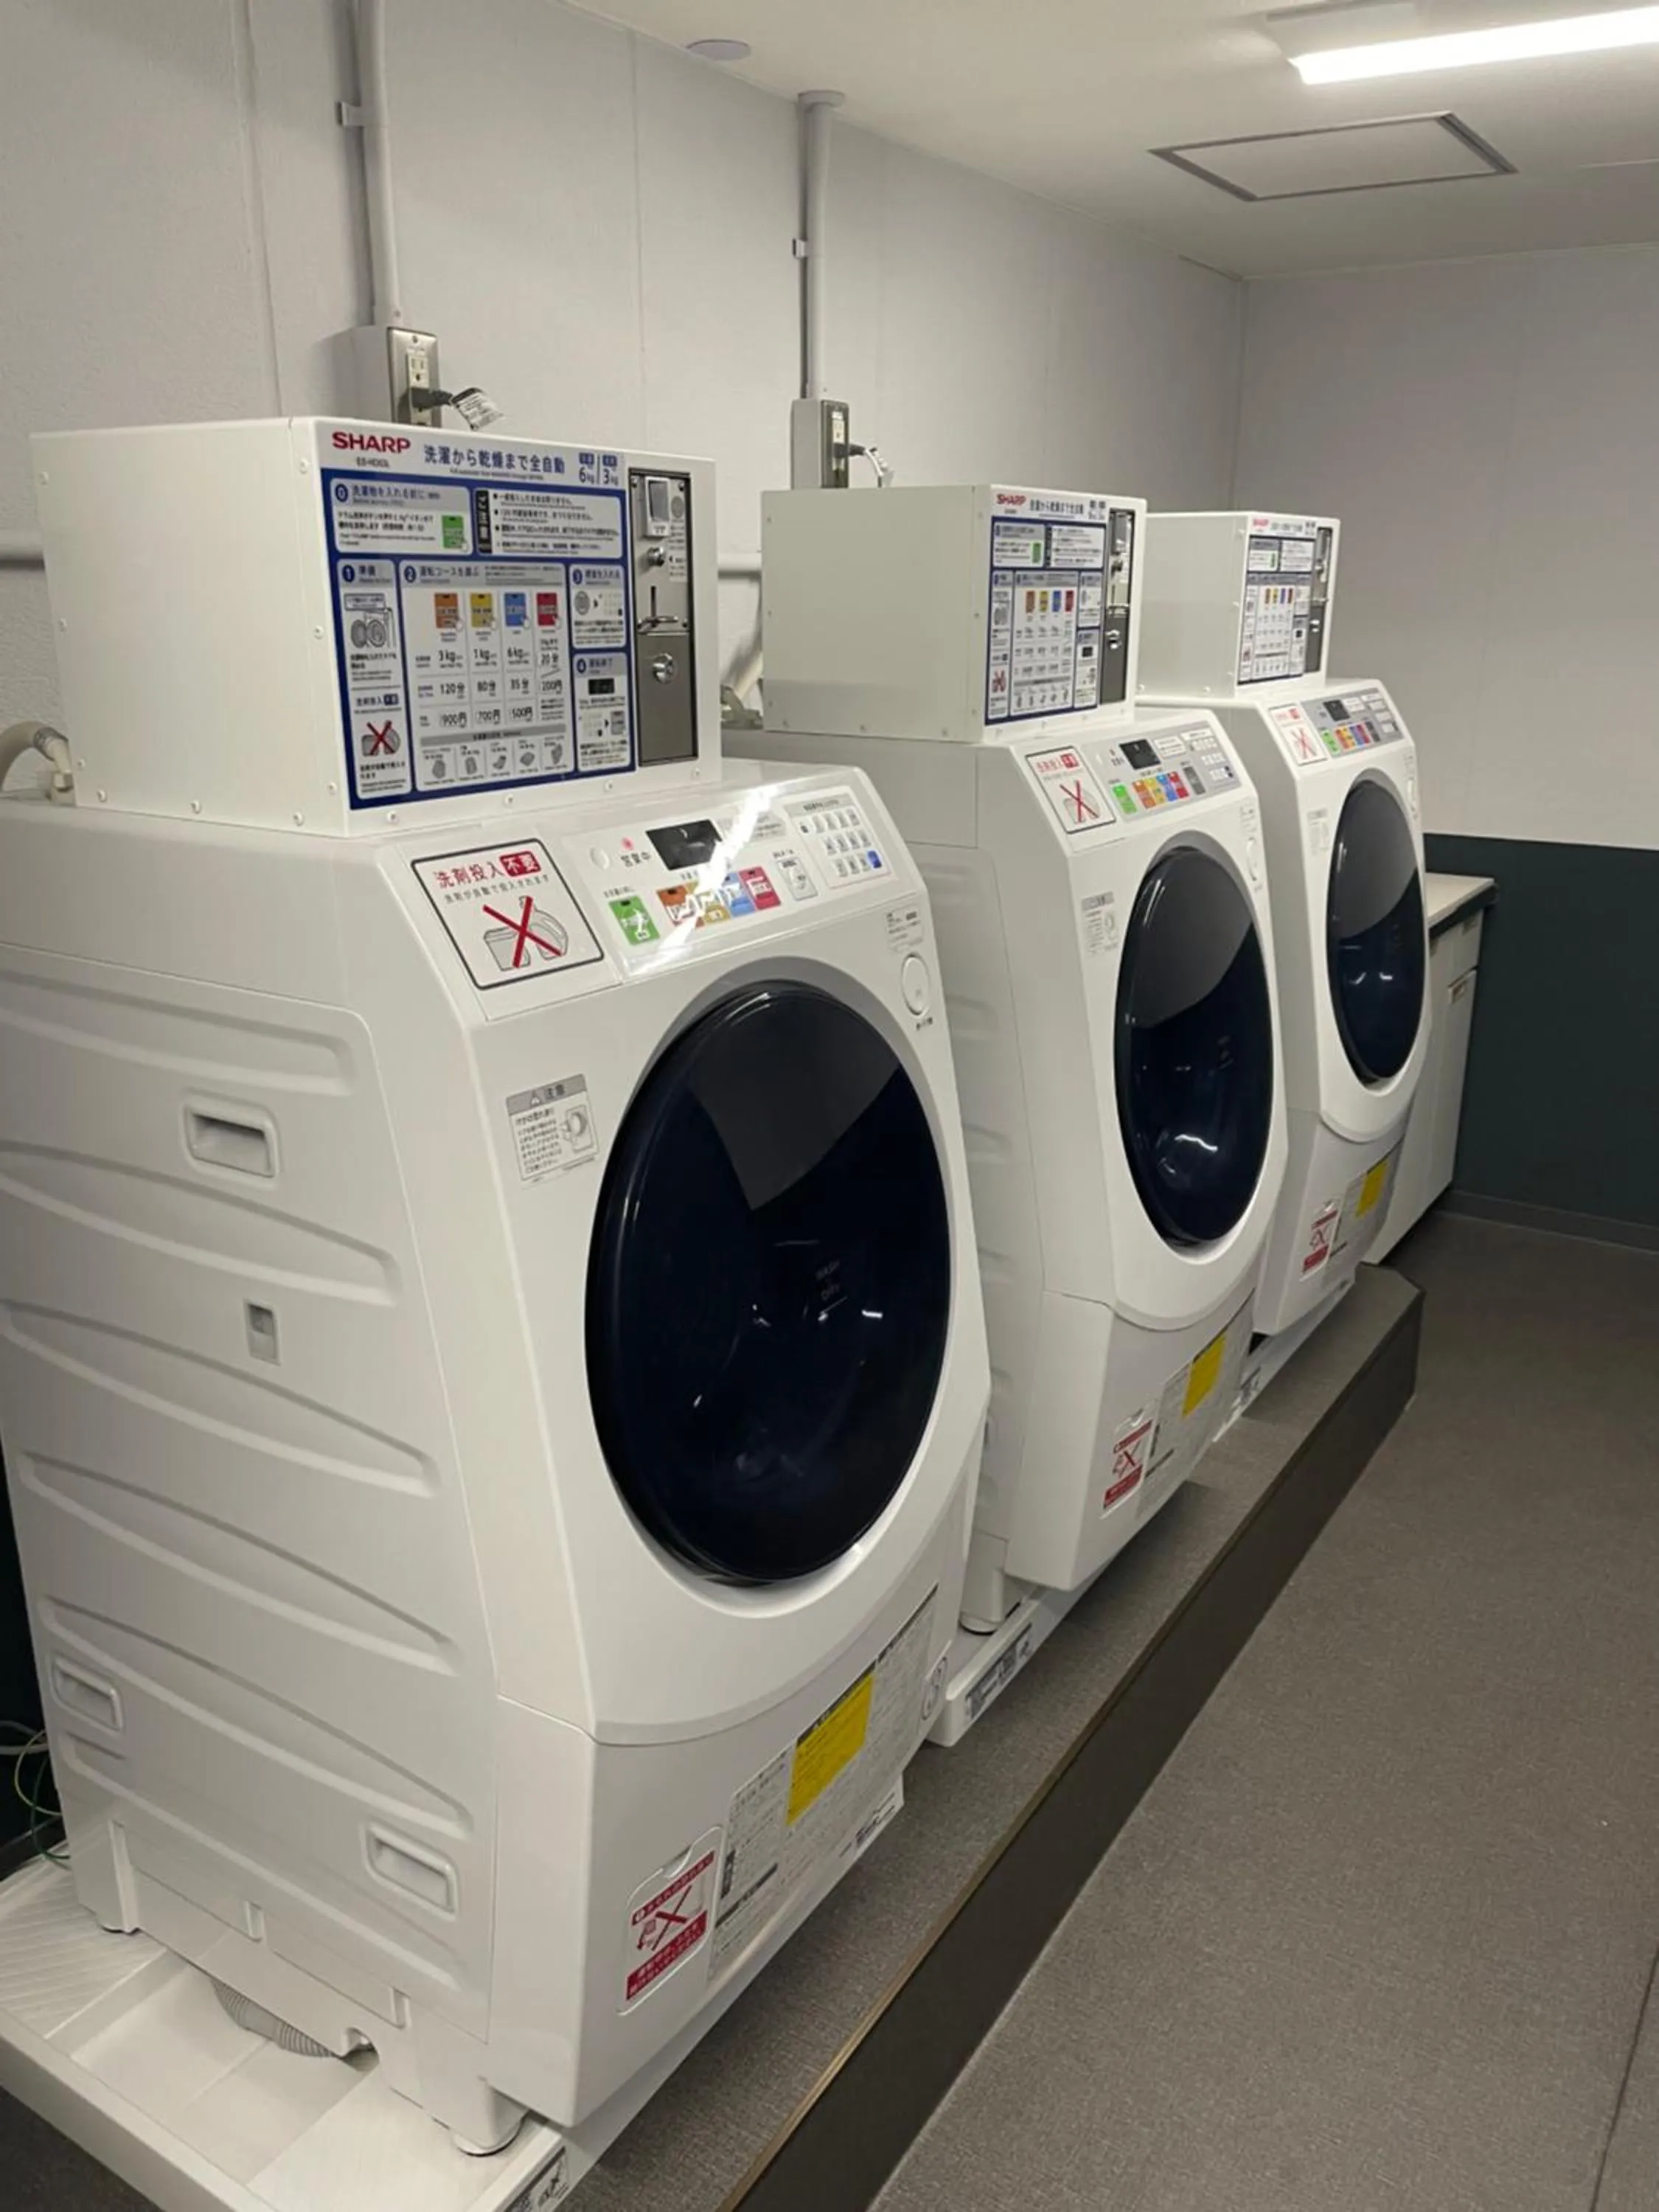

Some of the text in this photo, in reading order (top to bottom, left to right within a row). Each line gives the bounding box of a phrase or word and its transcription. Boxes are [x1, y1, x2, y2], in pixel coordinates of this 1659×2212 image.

[331, 431, 411, 454] SHARP
[424, 445, 566, 474] 洗濯から乾燥まで全自動
